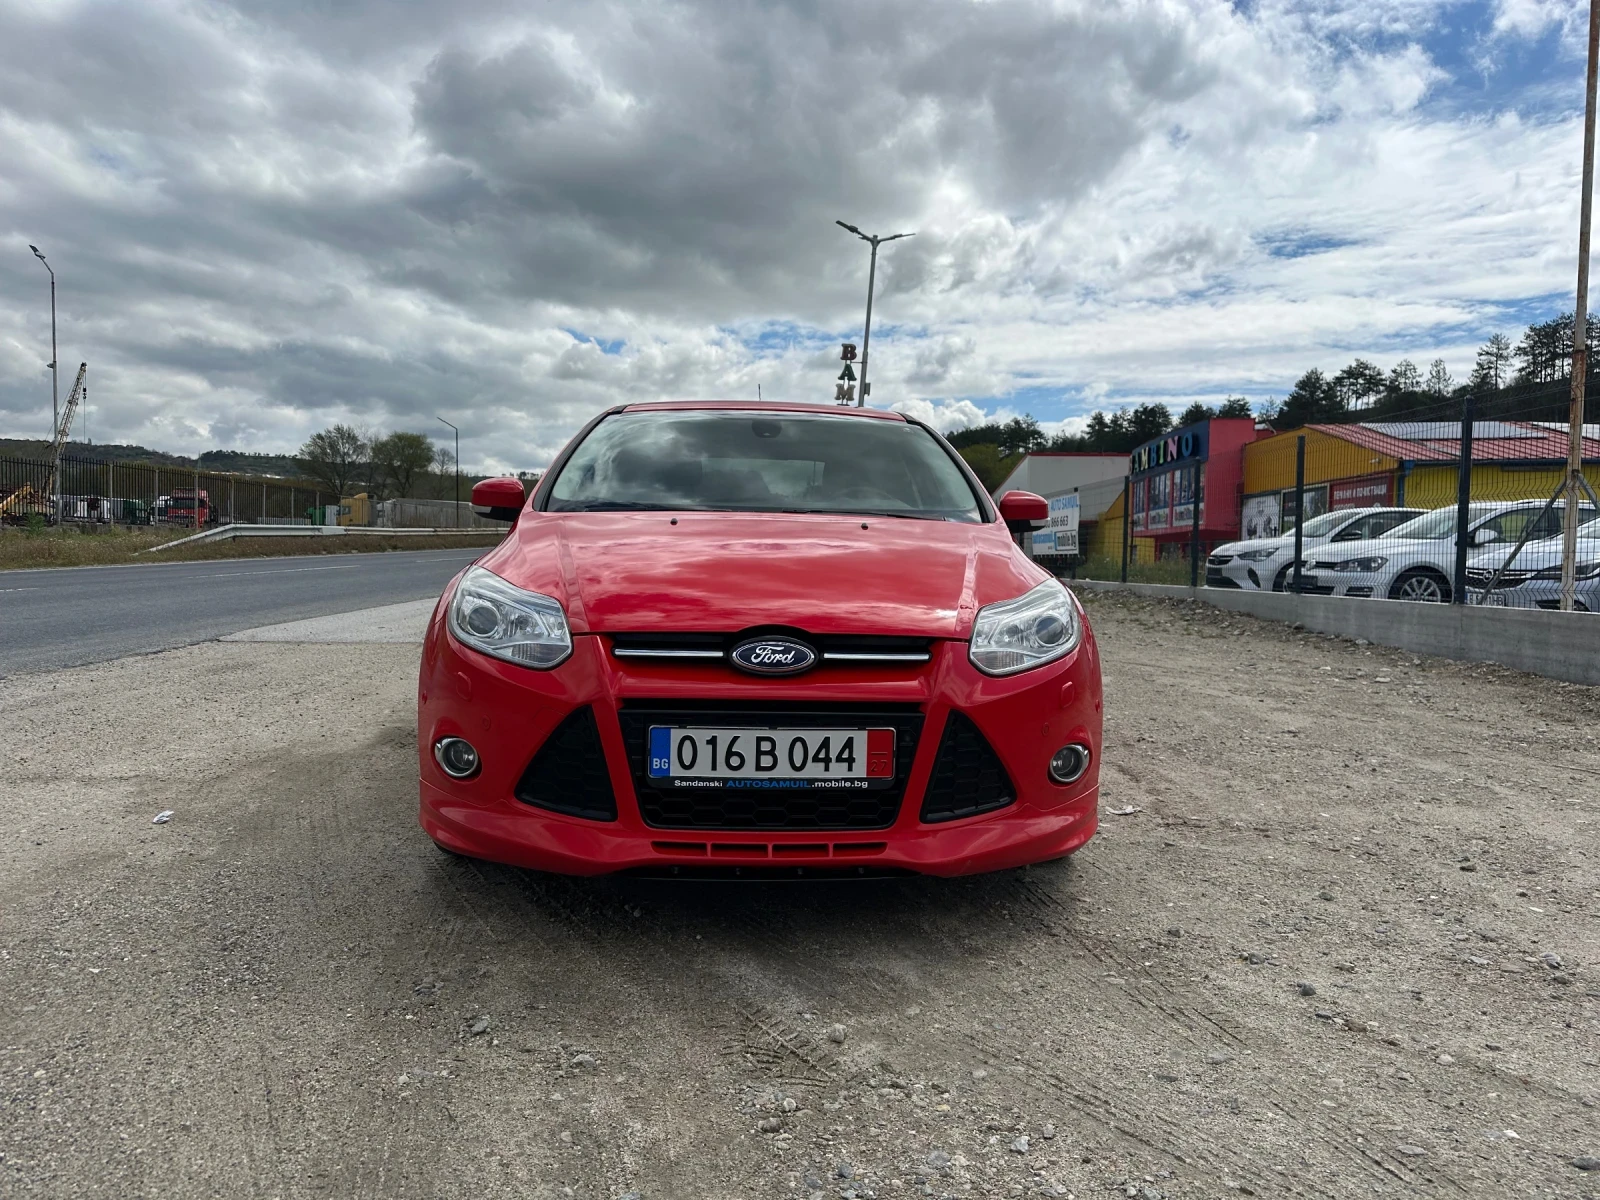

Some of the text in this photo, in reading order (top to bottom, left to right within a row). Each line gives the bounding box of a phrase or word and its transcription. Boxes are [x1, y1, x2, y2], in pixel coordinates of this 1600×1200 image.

[751, 645, 794, 665] Ford
[652, 758, 669, 769] BG
[674, 780, 723, 788] Sandanski
